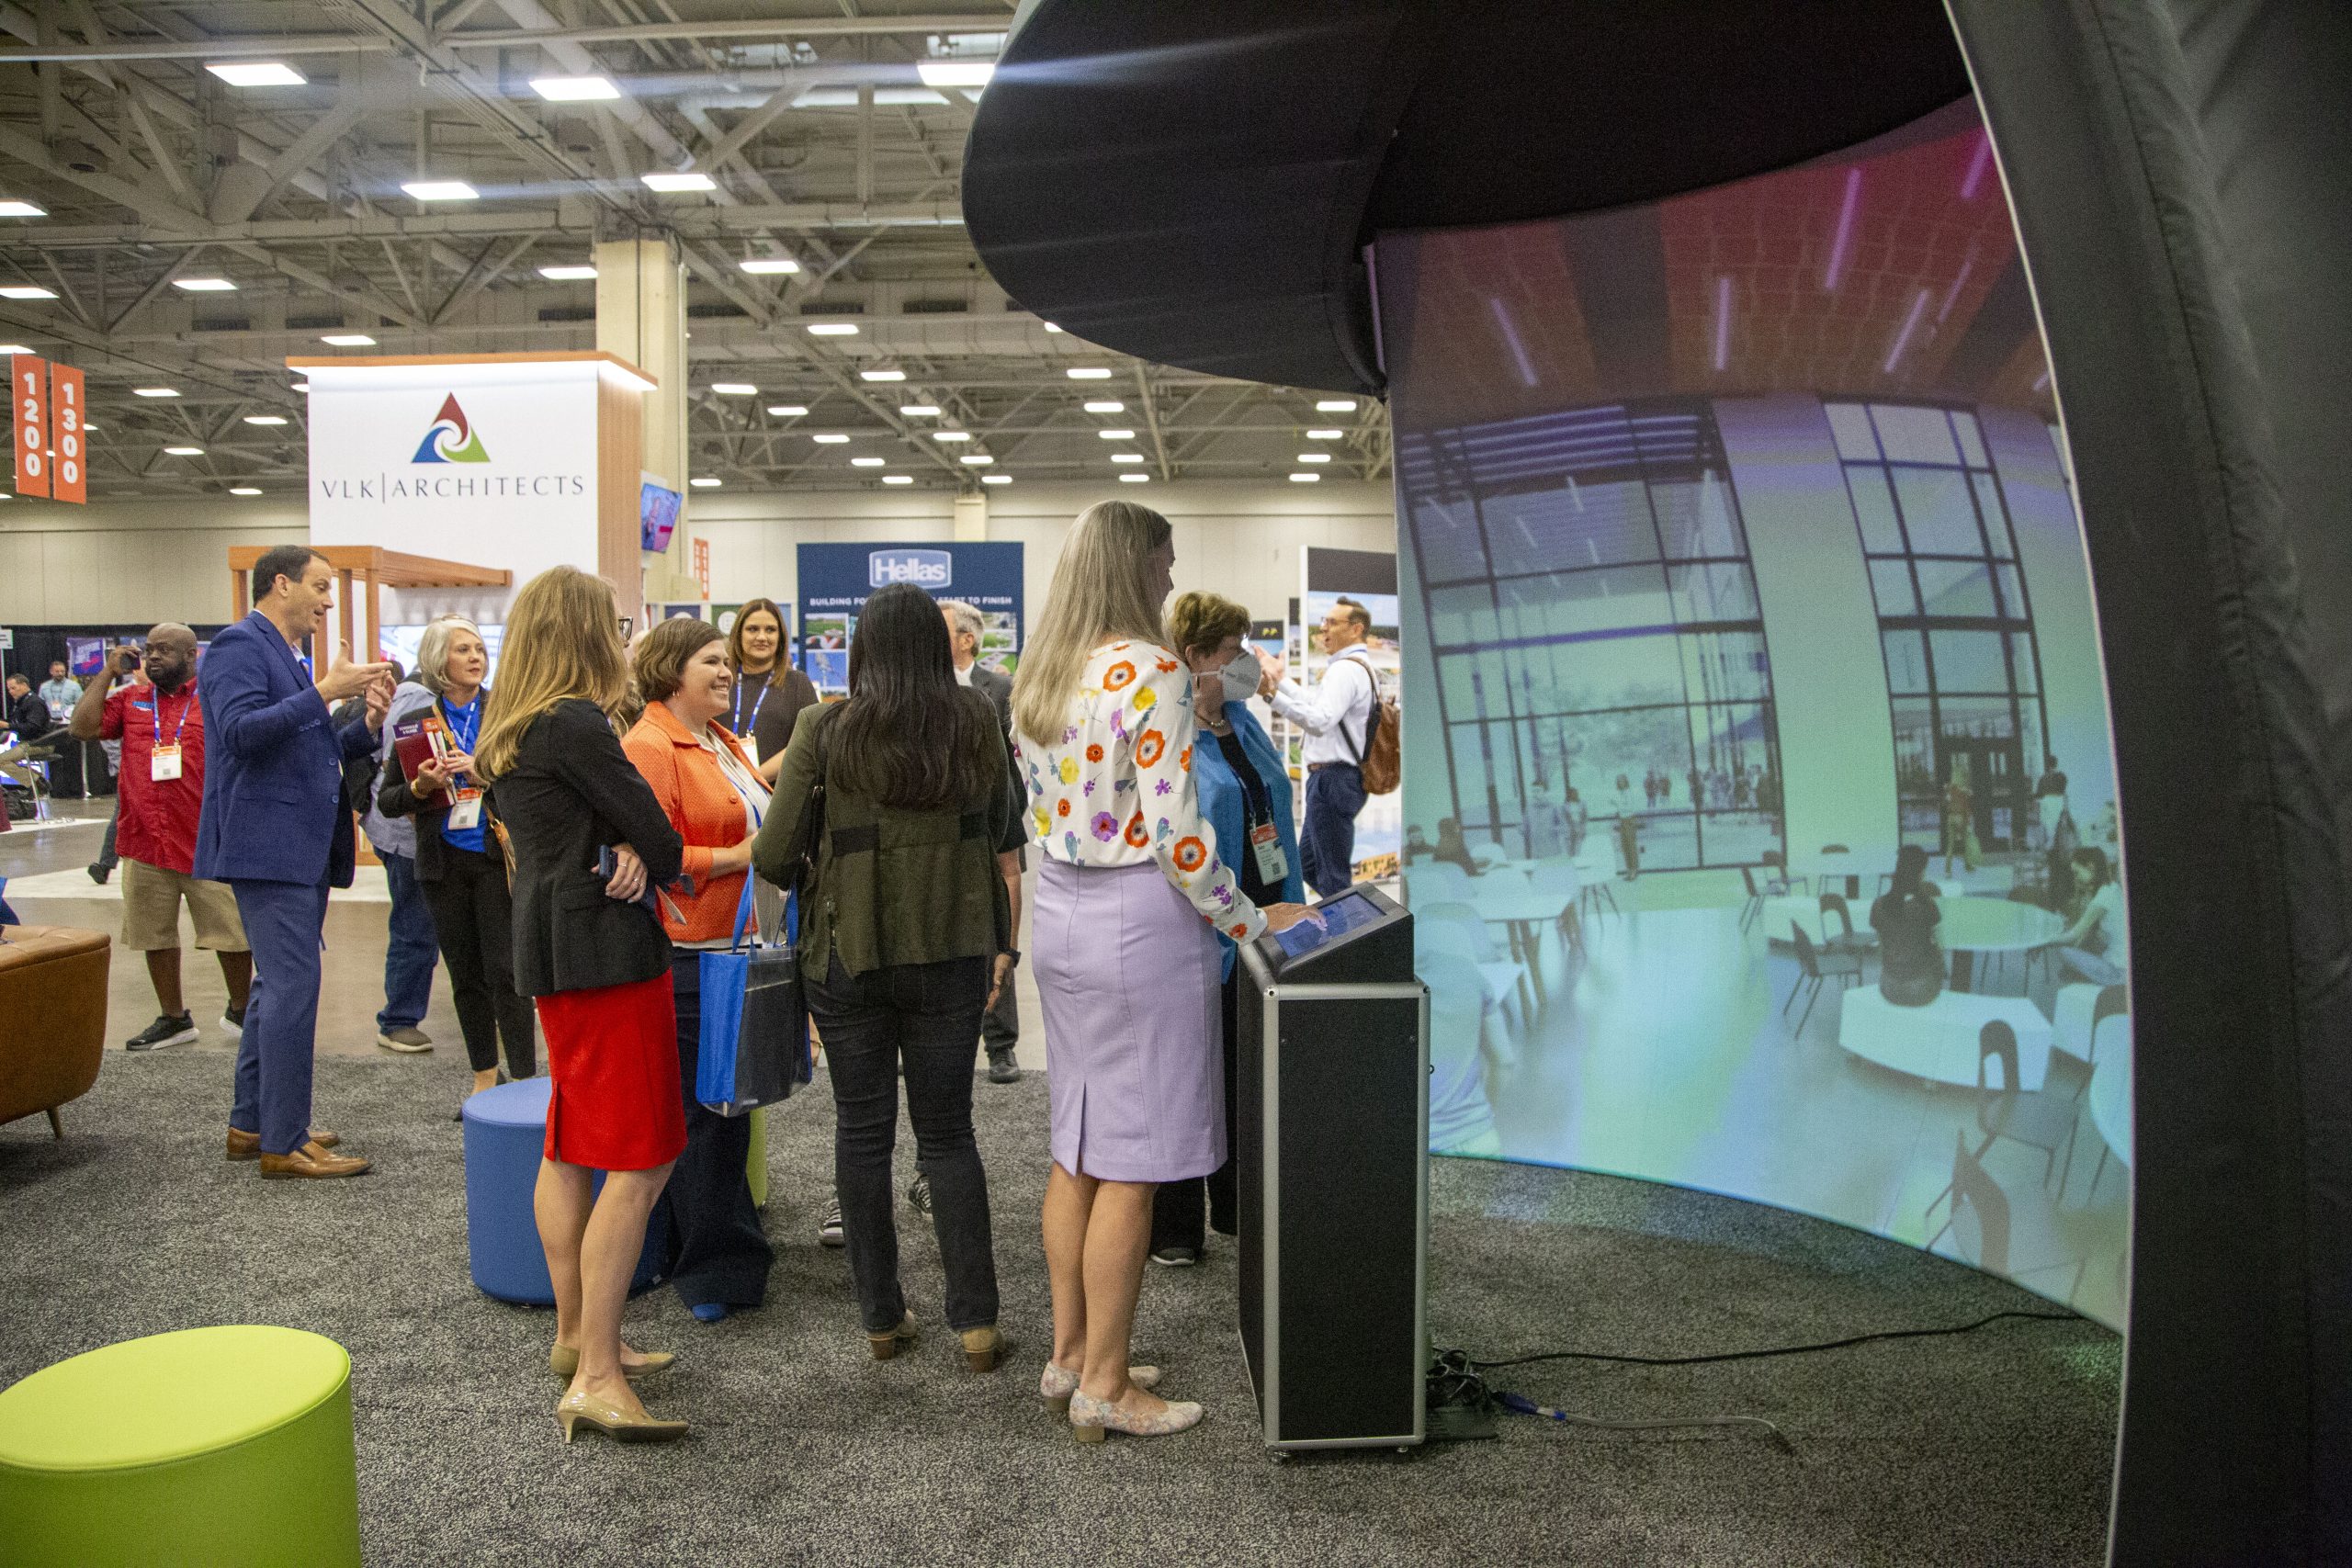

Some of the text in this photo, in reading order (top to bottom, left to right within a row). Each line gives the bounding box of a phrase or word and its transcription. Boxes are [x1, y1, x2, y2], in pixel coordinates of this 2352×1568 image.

[23, 372, 41, 477] 1200
[62, 382, 78, 484] 1300
[322, 476, 584, 498] VLK ARCHITECTS
[875, 558, 946, 581] Hellas
[809, 597, 853, 606] BUILDING
[967, 596, 981, 604] TO
[982, 596, 1012, 604] FINISH
